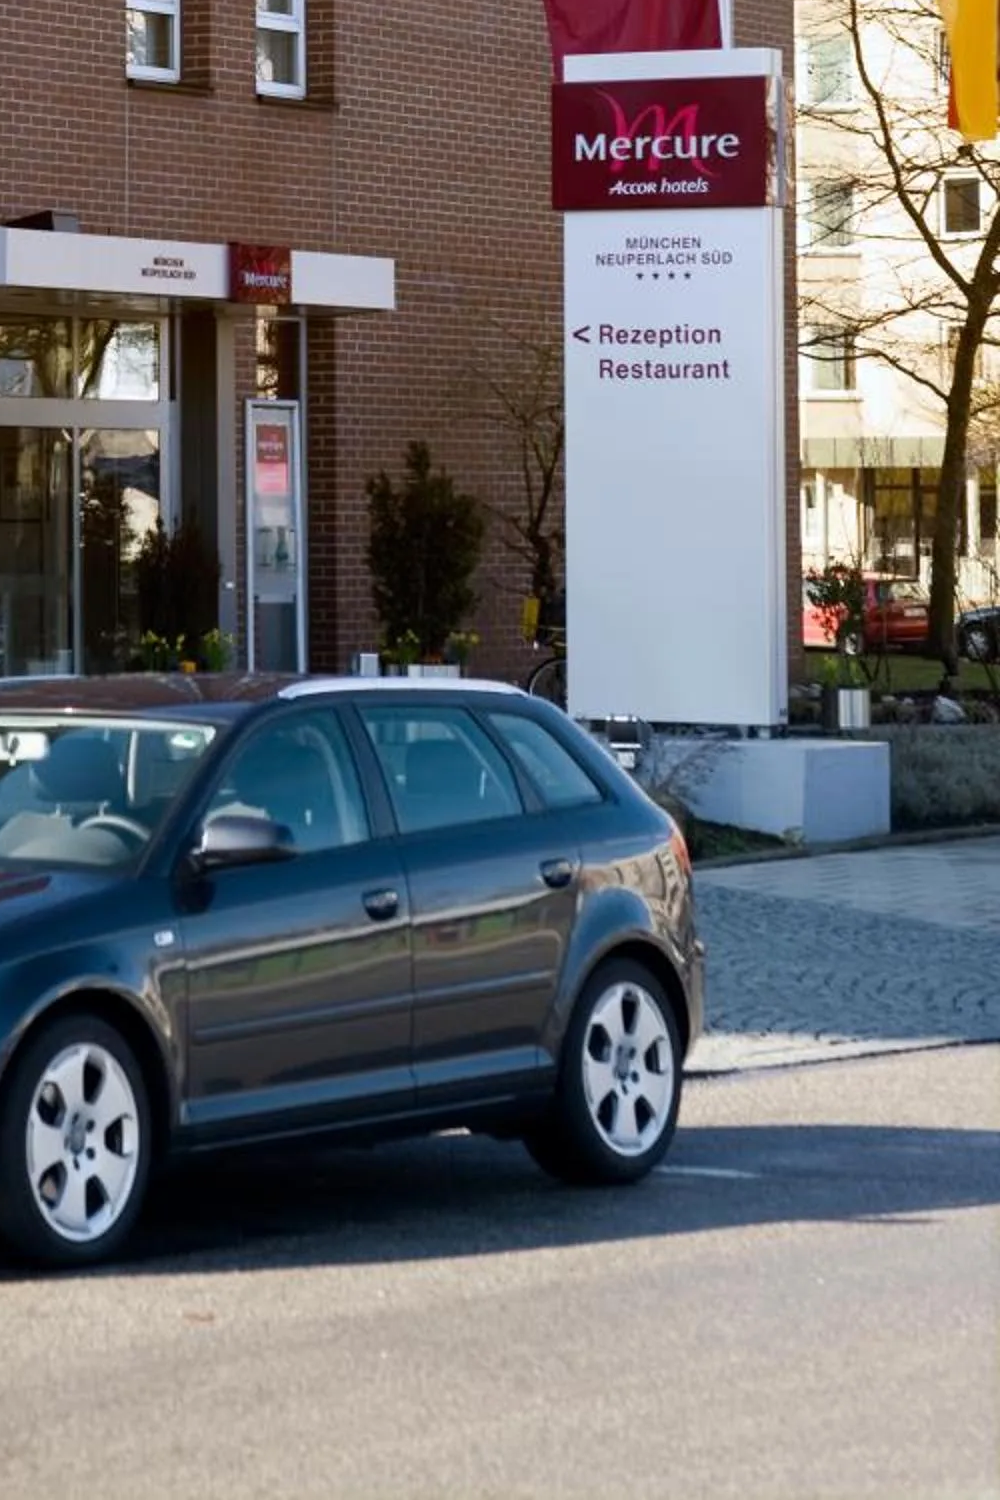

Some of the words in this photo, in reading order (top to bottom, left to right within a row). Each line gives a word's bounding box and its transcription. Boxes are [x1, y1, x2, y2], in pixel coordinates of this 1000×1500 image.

[574, 133, 740, 161] Mercure
[660, 177, 708, 194] hotels
[625, 235, 702, 249] MÜNCHEN
[595, 252, 696, 266] NEUPERLACH
[701, 249, 733, 265] SÜD
[598, 324, 722, 348] Rezeption
[598, 359, 730, 379] Restaurant
